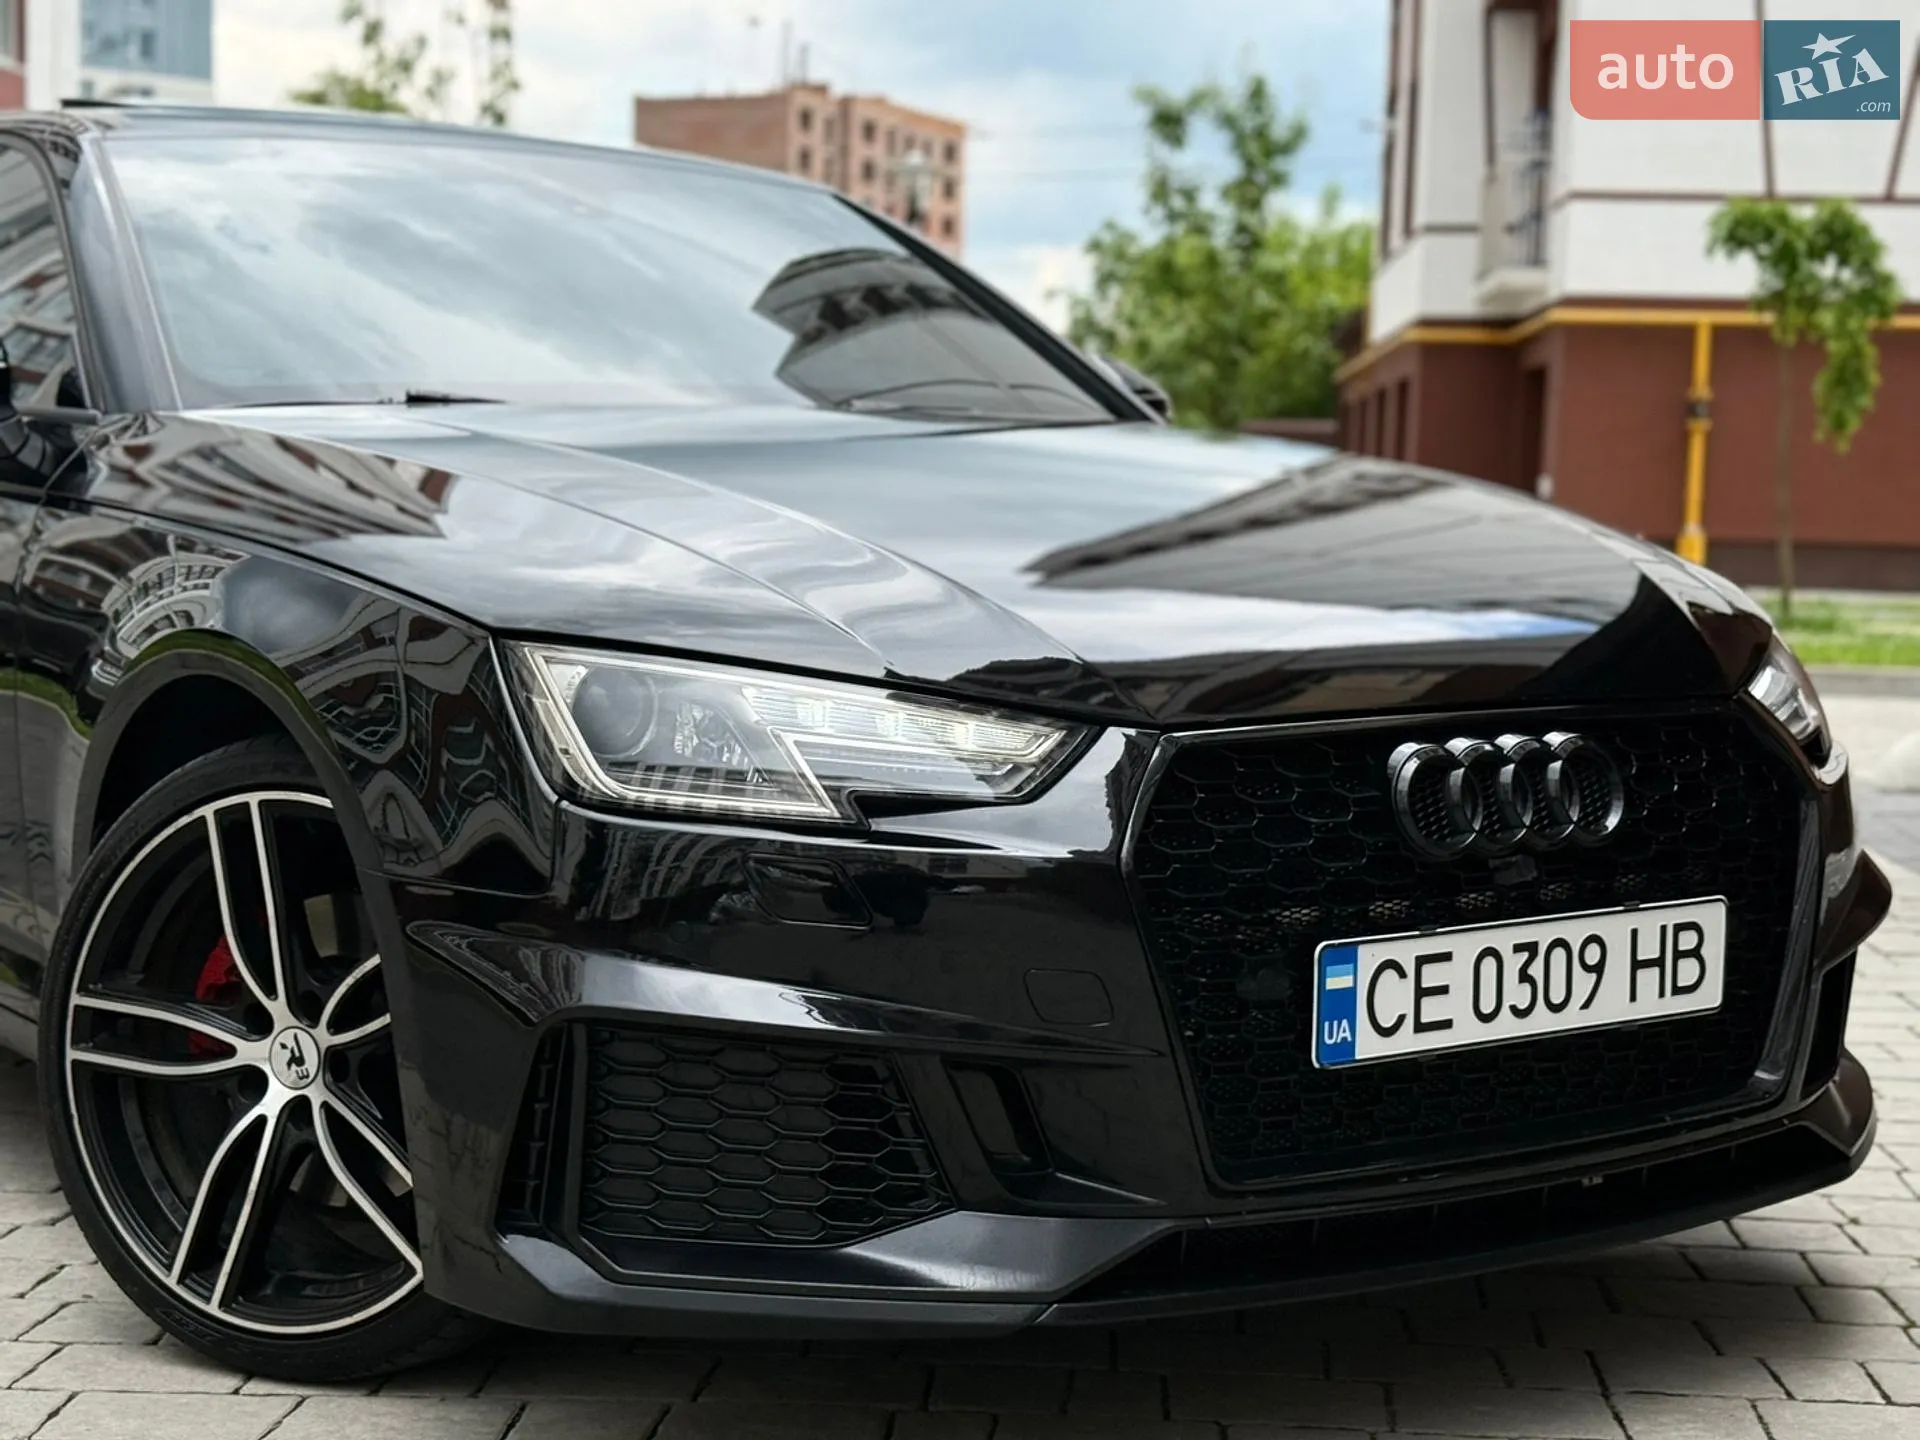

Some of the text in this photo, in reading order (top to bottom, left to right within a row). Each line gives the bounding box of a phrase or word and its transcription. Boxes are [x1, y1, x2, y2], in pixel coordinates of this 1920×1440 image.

[1366, 920, 1707, 1038] CE 0309 HB
[1323, 1018, 1352, 1045] UA
